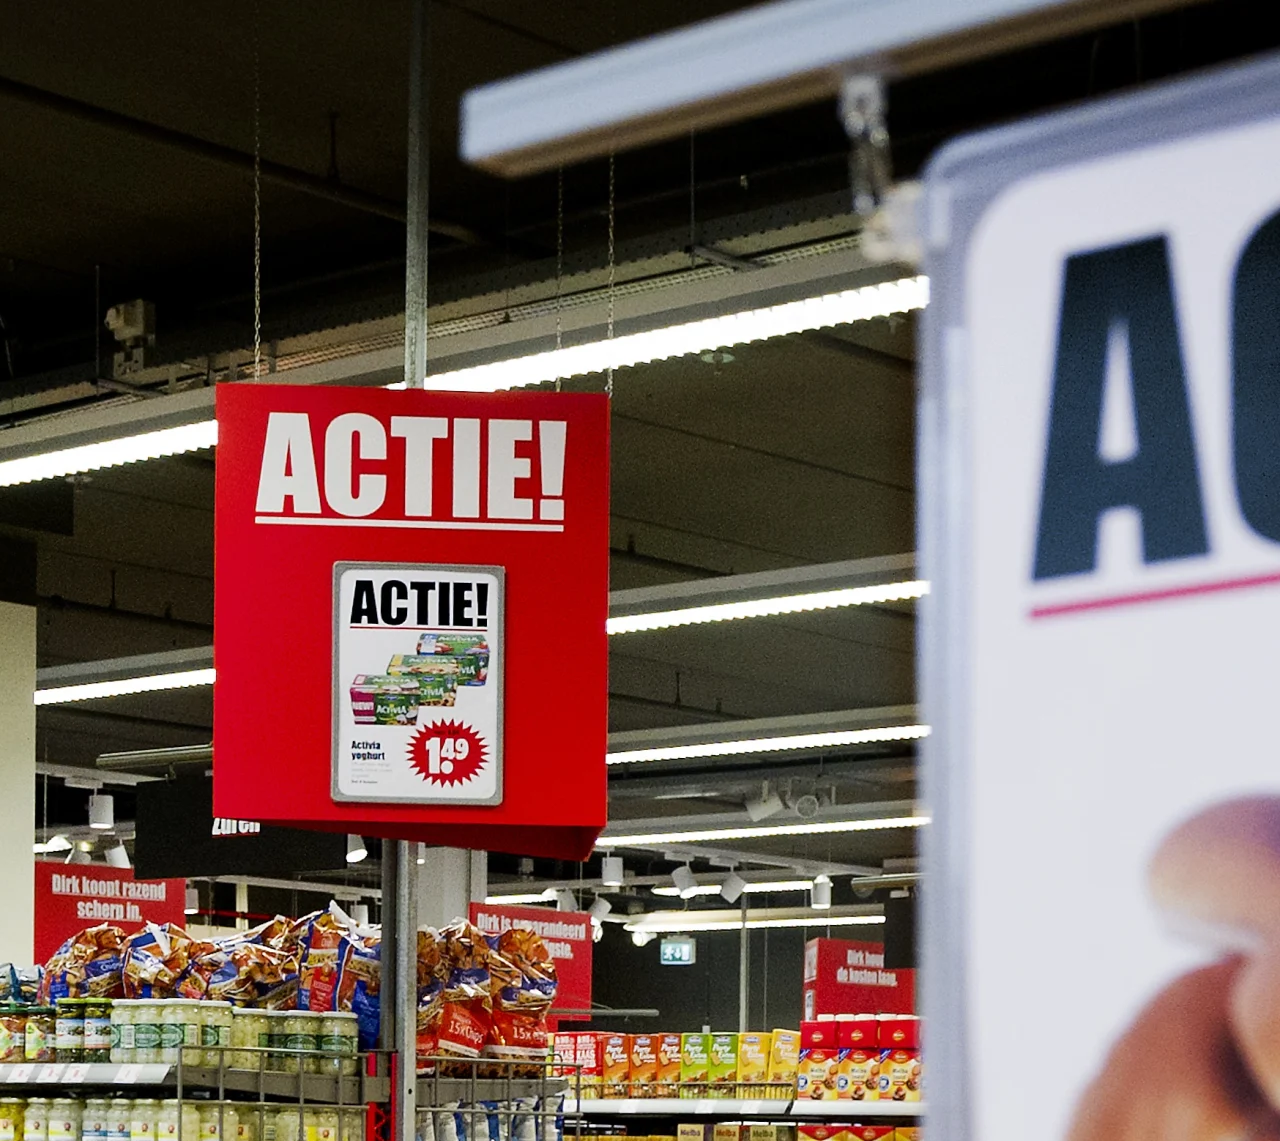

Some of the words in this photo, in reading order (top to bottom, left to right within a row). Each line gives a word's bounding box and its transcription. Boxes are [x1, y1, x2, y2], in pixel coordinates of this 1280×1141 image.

[255, 411, 567, 521] ACTIE!
[350, 579, 489, 627] ACTIE!
[351, 740, 381, 750] Activia
[351, 751, 385, 761] yoghurt
[52, 873, 80, 895] Dirk
[82, 876, 121, 899] koopt
[122, 881, 166, 900] razend
[77, 900, 123, 921] scherp
[126, 902, 142, 921] in.
[477, 912, 499, 932] Dirk
[501, 915, 511, 930] is
[680, 1128, 701, 1137] Melba
[716, 1128, 736, 1137] Melba
[752, 1129, 773, 1138] Melba
